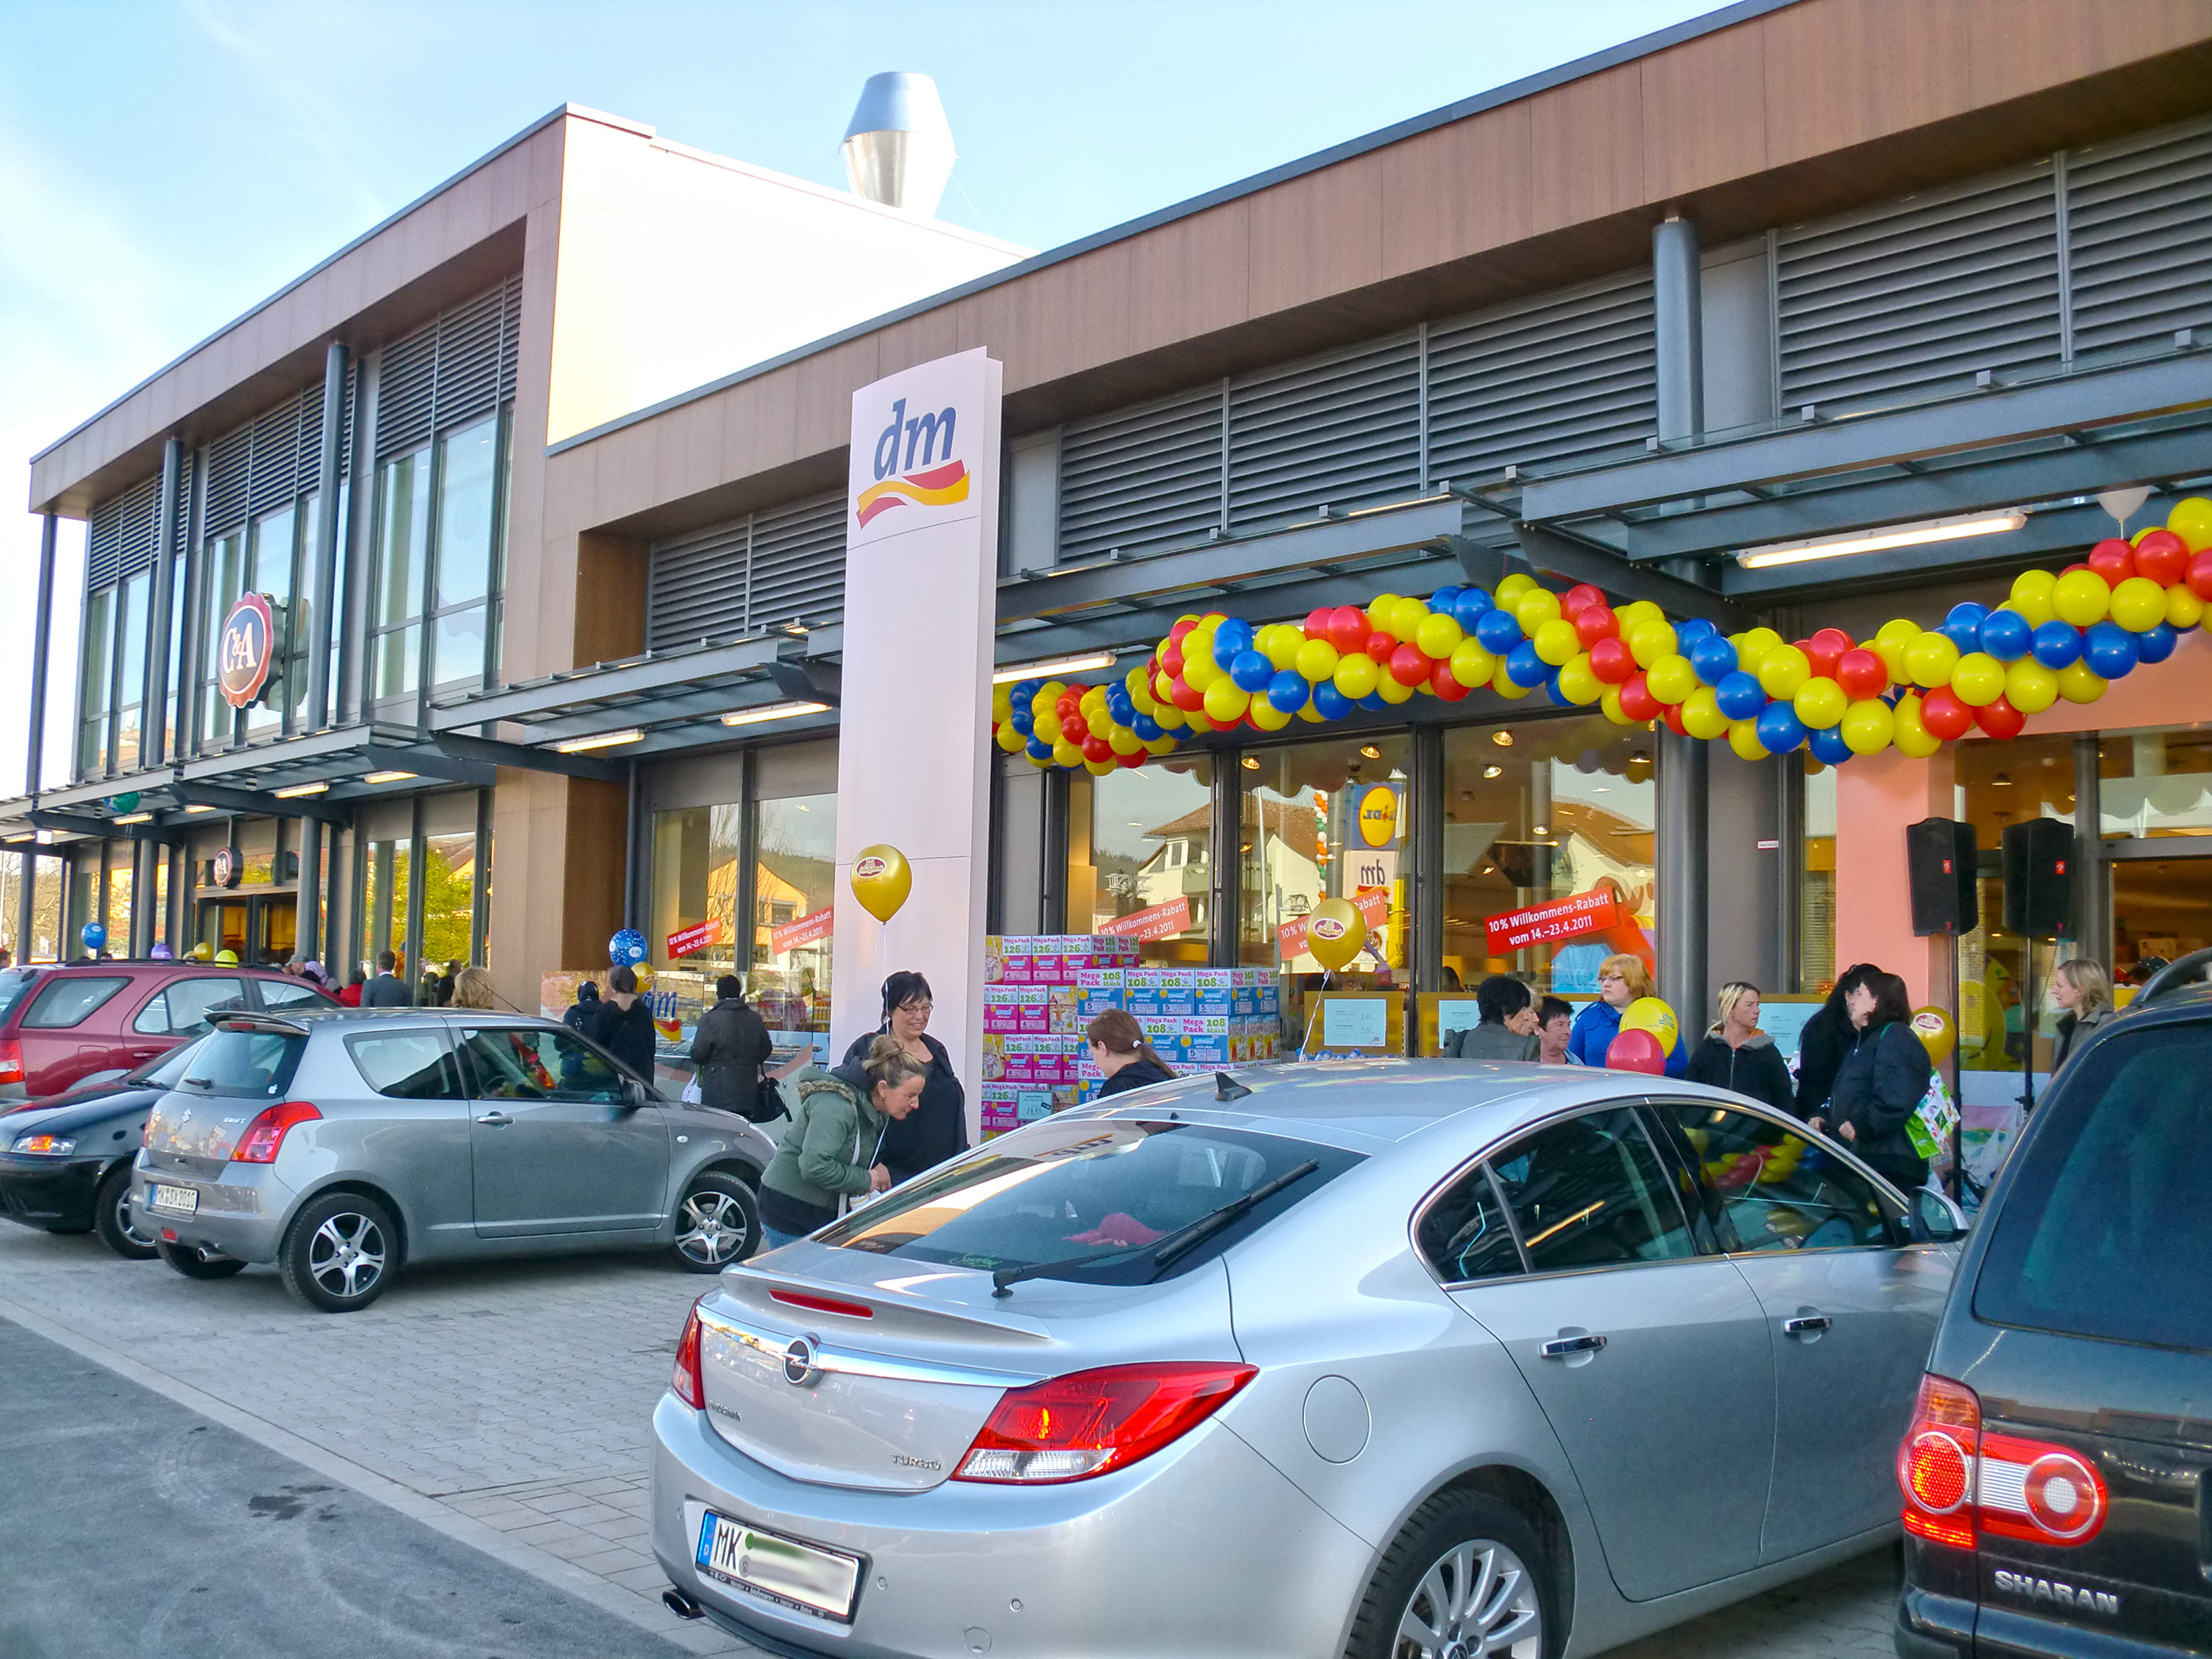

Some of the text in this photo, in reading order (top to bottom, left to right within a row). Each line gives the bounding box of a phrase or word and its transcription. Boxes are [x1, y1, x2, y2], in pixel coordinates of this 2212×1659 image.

[873, 397, 956, 481] dm
[223, 622, 257, 673] C&A
[1115, 901, 1185, 934] Willkommens-Rabatt
[1488, 893, 1609, 933] 10% Willkommens-Rabatt
[783, 910, 831, 936] Willkommens-Rabatt
[678, 921, 720, 942] Willkommens-Rabatt
[1280, 925, 1297, 939] 10%
[782, 940, 793, 948] vom
[1508, 933, 1530, 946] vom
[1003, 945, 1022, 954] 126
[1033, 945, 1050, 954] 126
[1062, 944, 1080, 953] 126
[1298, 941, 1308, 949] vo
[1103, 971, 1121, 980] 108
[1128, 977, 1147, 987] 108
[1161, 977, 1181, 987] 108
[1197, 977, 1217, 987] 108
[991, 994, 1008, 1002] 126
[1020, 994, 1036, 1002] 126
[1183, 1018, 1204, 1027] Mega
[1206, 1017, 1225, 1027] 108
[1147, 1023, 1166, 1033] 108
[1005, 1043, 1022, 1052] 126
[1034, 1043, 1051, 1052] 126
[992, 1091, 1008, 1100] 126
[891, 1454, 941, 1471] TURBO
[703, 1543, 710, 1556] D
[713, 1523, 743, 1571] MK
[1993, 1569, 2120, 1615] SHARAN
